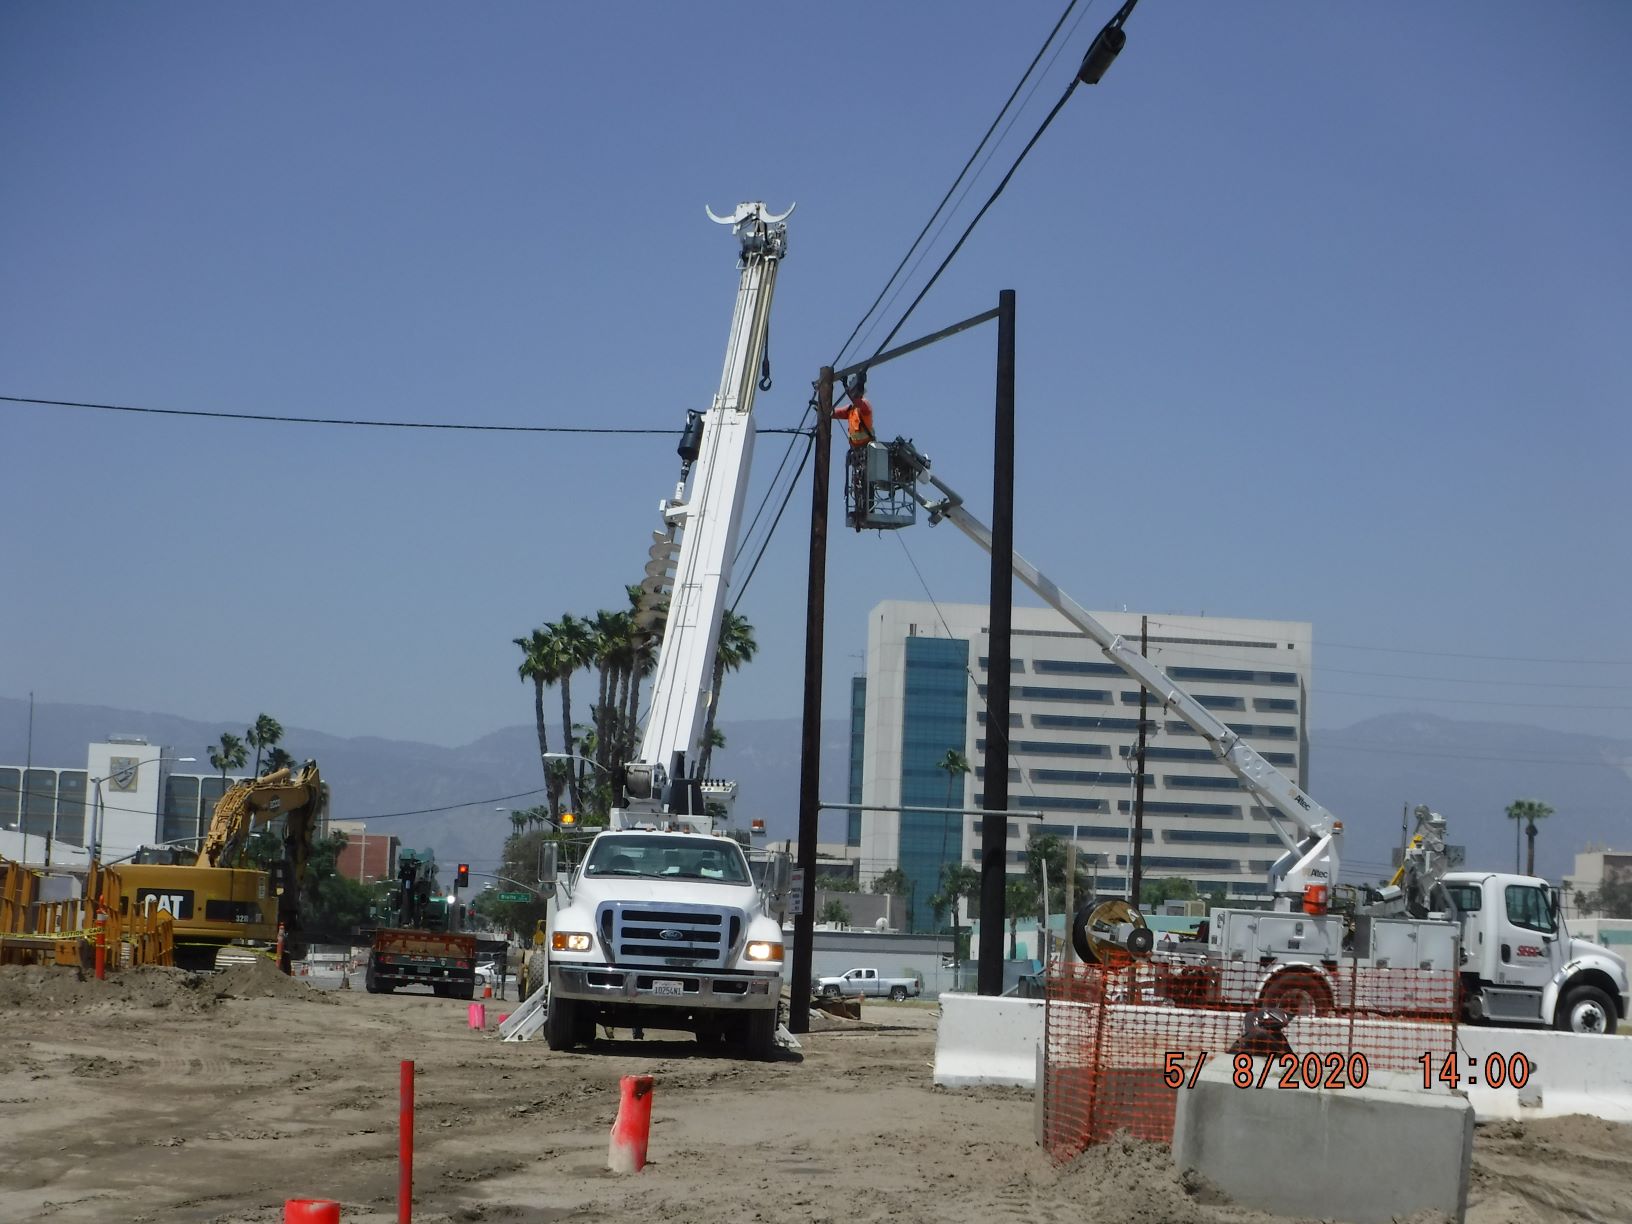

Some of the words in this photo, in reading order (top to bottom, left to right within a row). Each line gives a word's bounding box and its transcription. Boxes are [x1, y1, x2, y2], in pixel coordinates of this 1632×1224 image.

[1294, 795, 1311, 811] Altec
[1310, 868, 1328, 878] Altec
[144, 894, 184, 920] CAT
